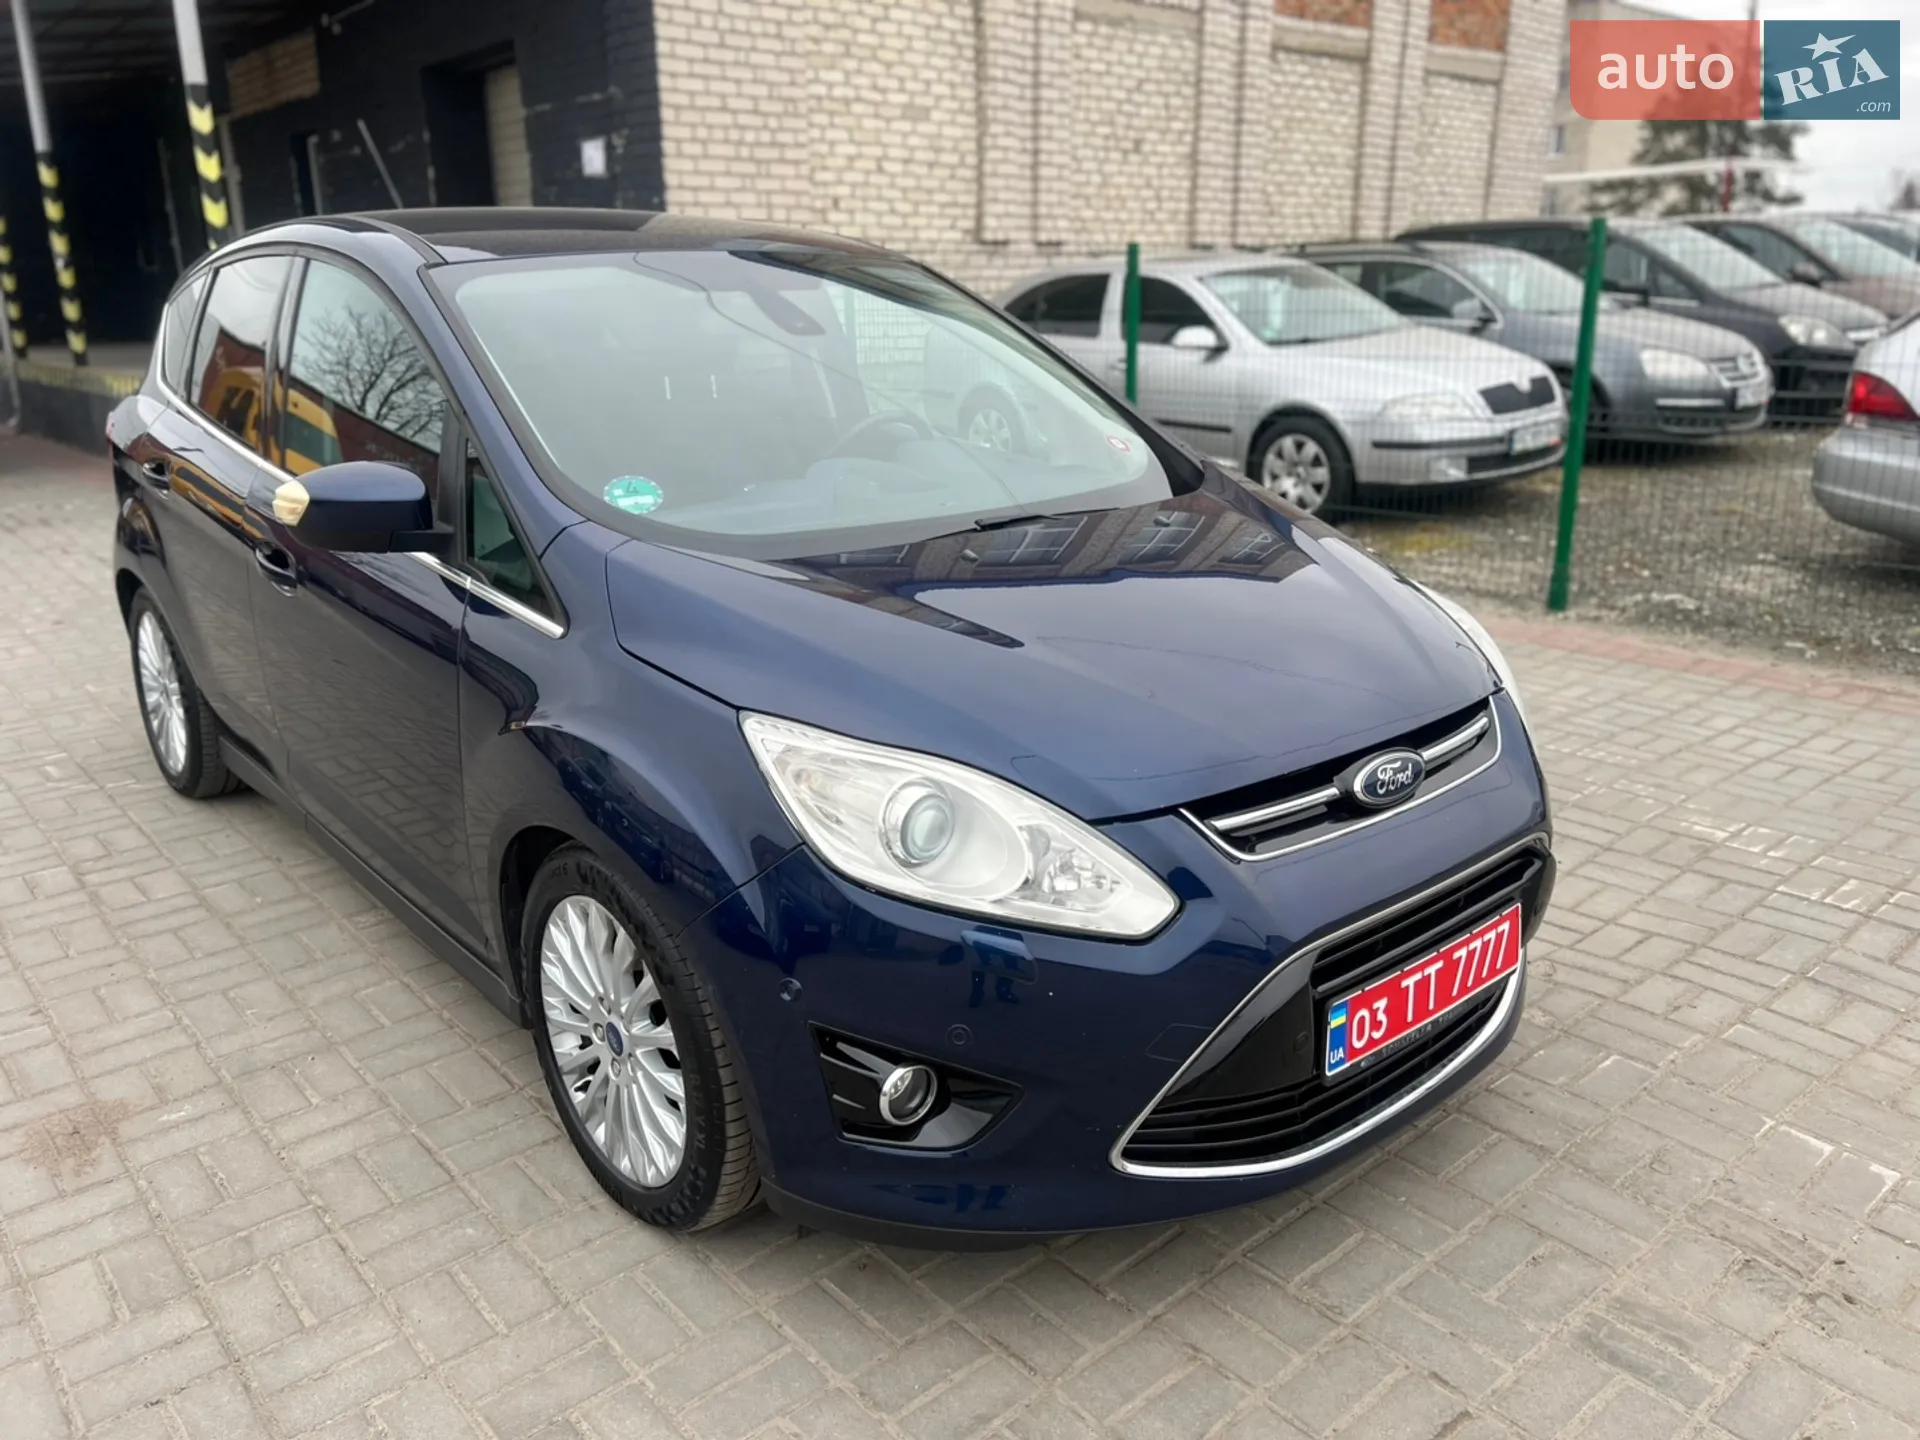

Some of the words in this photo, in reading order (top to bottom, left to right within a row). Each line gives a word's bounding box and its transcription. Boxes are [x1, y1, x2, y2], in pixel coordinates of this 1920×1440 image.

[1376, 760, 1413, 795] Ford
[1351, 996, 1388, 1049] 03
[1401, 959, 1444, 1023] TT
[1451, 920, 1511, 998] 7777
[1329, 1046, 1345, 1064] UA
